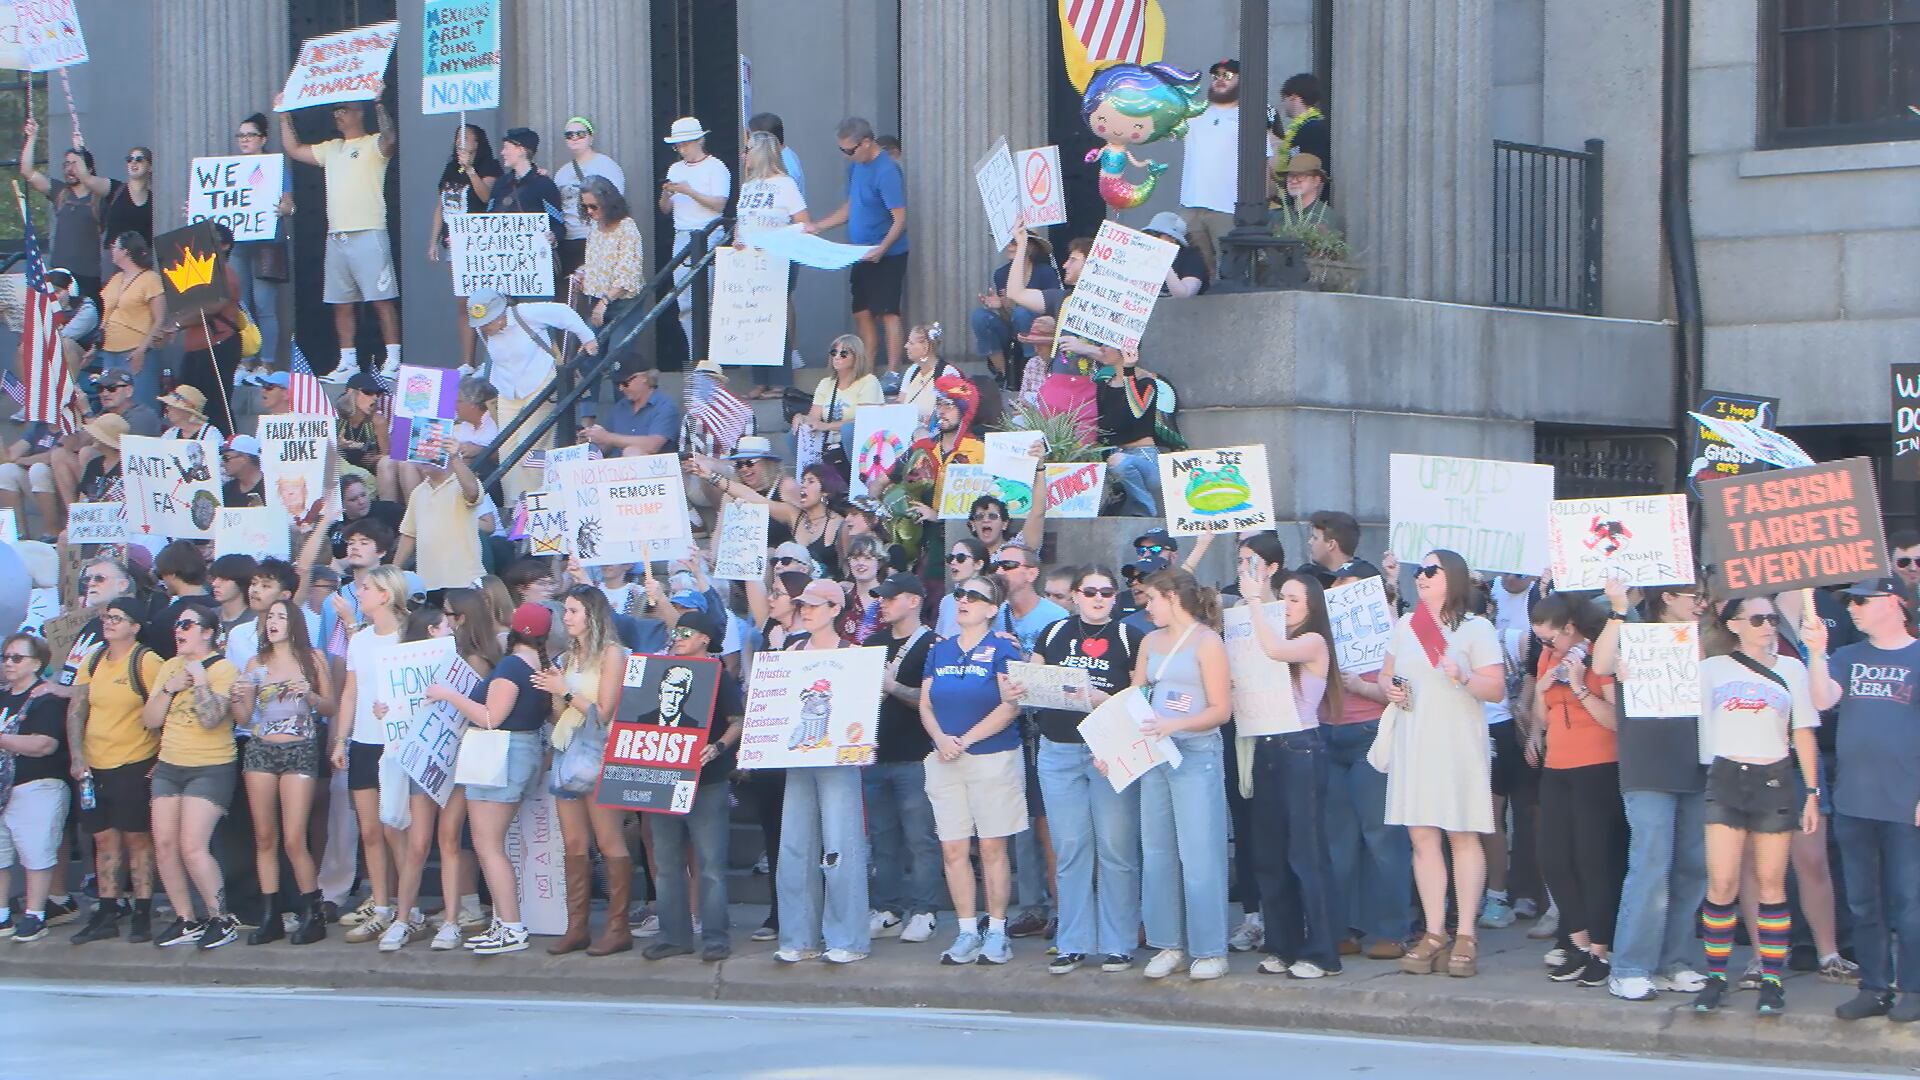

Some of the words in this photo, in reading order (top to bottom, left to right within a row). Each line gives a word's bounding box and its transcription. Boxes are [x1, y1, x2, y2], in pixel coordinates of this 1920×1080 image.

[428, 20, 485, 43] AREN'T
[427, 41, 477, 59] GOING
[431, 81, 458, 108] NO
[196, 162, 240, 188] WE
[203, 188, 253, 210] THE
[454, 215, 546, 233] HISTORIANS
[466, 233, 533, 251] AGAINST
[1092, 243, 1113, 260] NO
[466, 252, 537, 272] HISTORY
[462, 272, 542, 294] REPEATING
[1717, 402, 1726, 413] I
[266, 420, 329, 440] FAUX-KING
[280, 440, 318, 462] JOKE
[1419, 456, 1512, 495] UPHOLD
[609, 484, 667, 499] REMOVE
[1721, 469, 1855, 517] FASCISM
[152, 491, 176, 514] FA
[616, 502, 663, 517] TRUMP
[1444, 497, 1488, 525] THE
[1550, 502, 1610, 515] FOLLOW
[1621, 501, 1658, 514] THE
[1727, 506, 1861, 552] TARGETS
[1723, 540, 1879, 589] EVERYONE
[1566, 563, 1677, 588] LEADER
[1331, 601, 1391, 643] ICE
[1625, 627, 1661, 643] WE
[1070, 638, 1078, 656] I
[629, 659, 640, 674] K
[759, 653, 781, 663] When
[1058, 655, 1110, 670] JESUS
[389, 664, 441, 698] HONK
[755, 667, 792, 680] Injustice
[1850, 663, 1912, 682] DOLLY
[751, 686, 788, 700] Becomes
[1850, 680, 1893, 698] REBA
[749, 701, 768, 713] Law
[744, 716, 790, 728] Resistance
[614, 729, 698, 764] RESIST
[743, 733, 780, 744] Becomes
[743, 749, 764, 762] Duty
